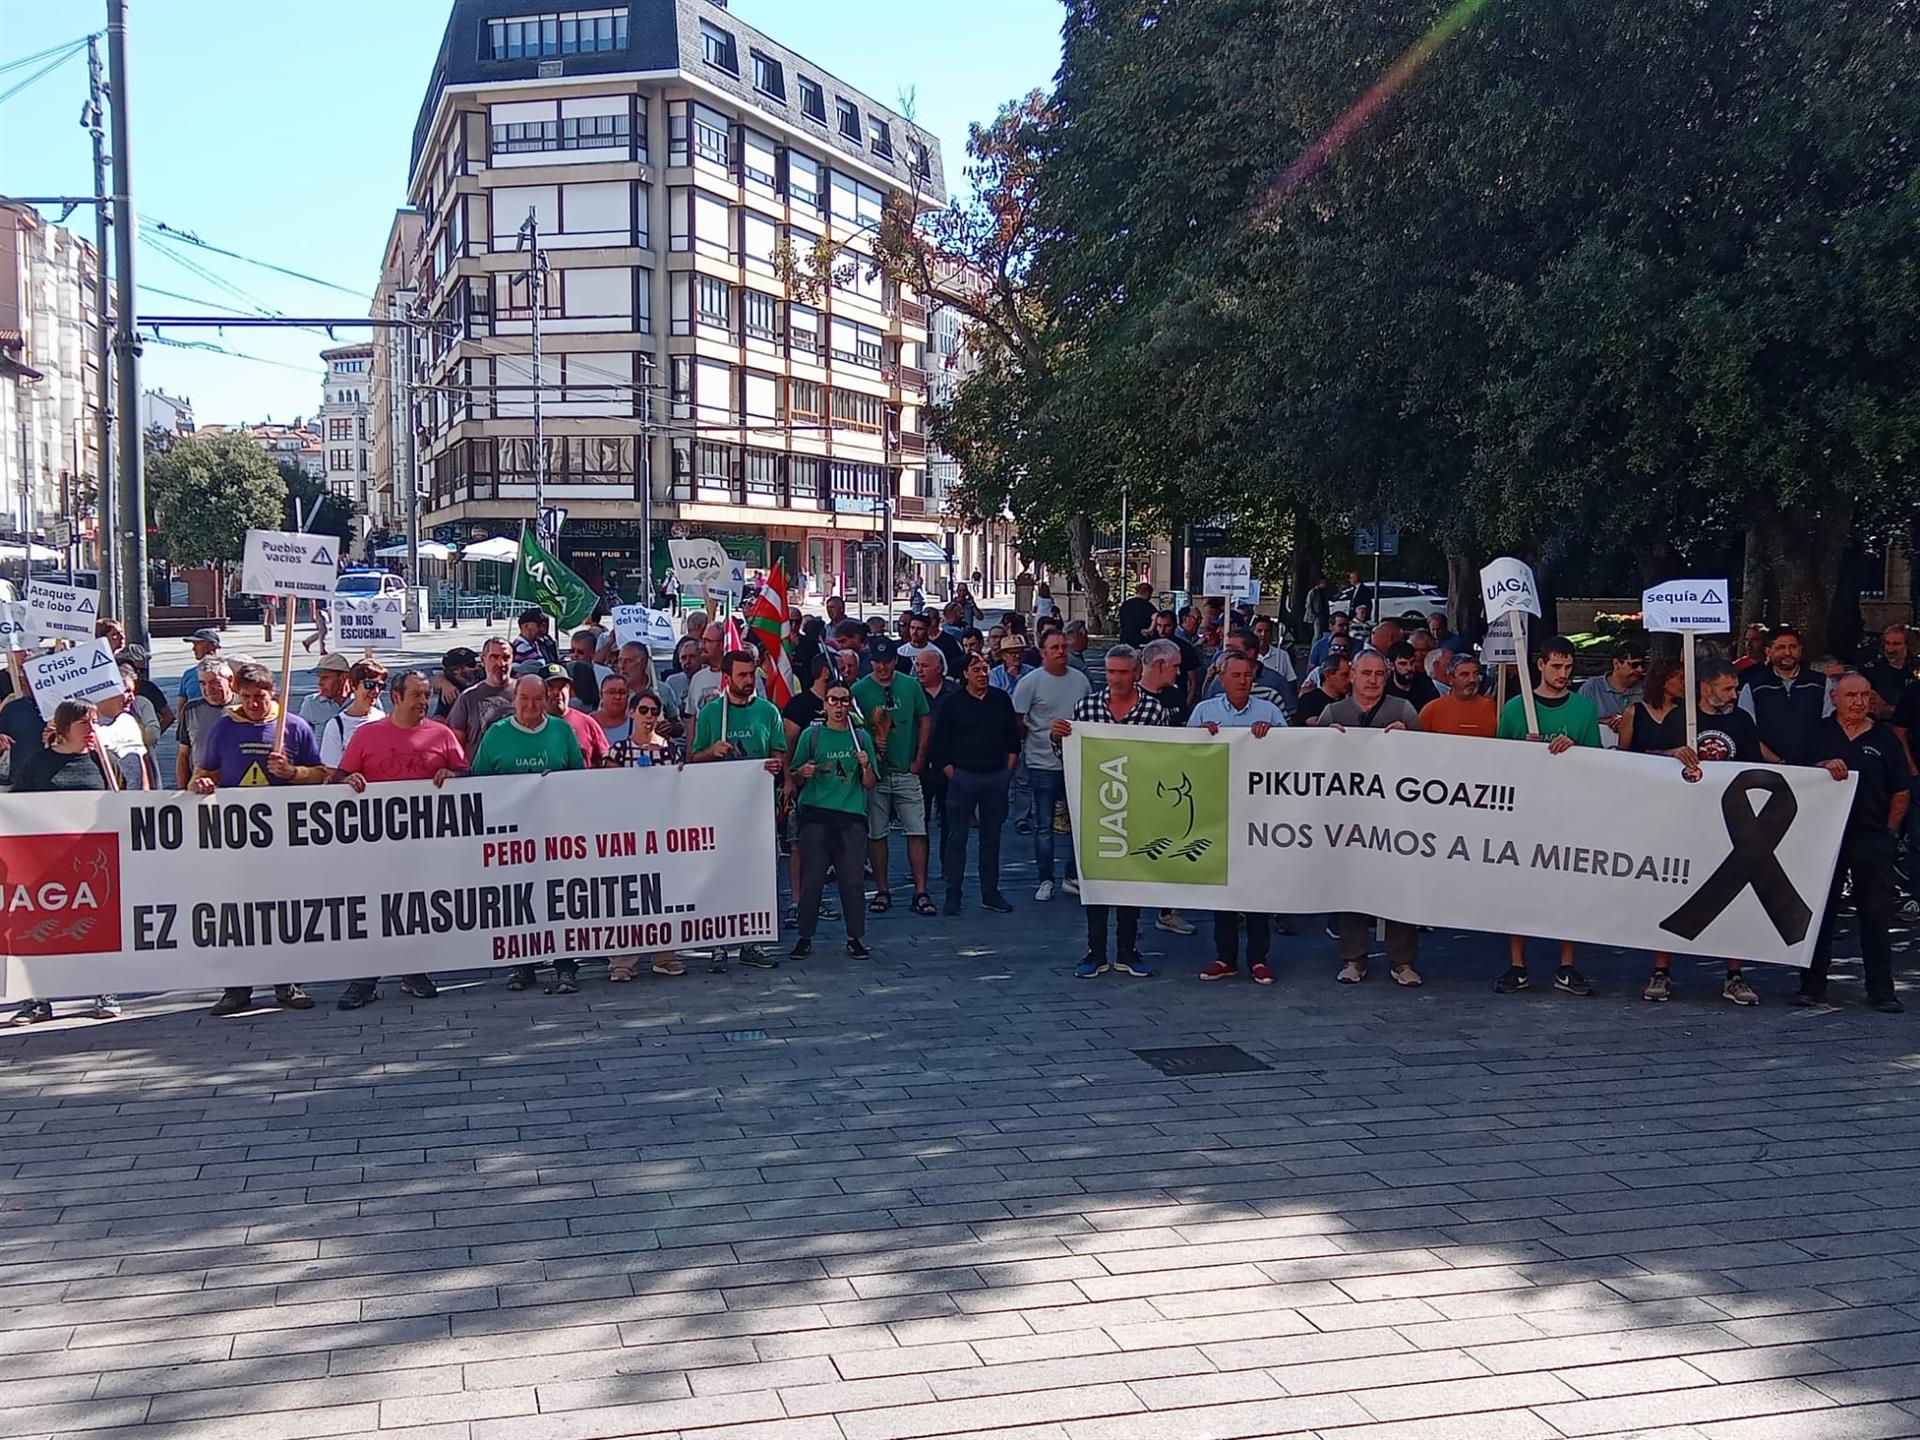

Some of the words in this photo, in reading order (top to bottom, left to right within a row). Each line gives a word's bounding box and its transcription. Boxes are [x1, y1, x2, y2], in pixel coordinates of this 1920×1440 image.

[262, 541, 308, 555] Pueblos
[678, 556, 720, 570] UAGA
[30, 585, 77, 601] Ataques
[1487, 578, 1531, 600] UAGA
[1647, 590, 1698, 605] sequía
[31, 598, 45, 609] de
[47, 600, 72, 613] lobo
[0, 622, 25, 635] GA
[340, 615, 353, 626] NO
[355, 615, 374, 626] NOS
[616, 616, 632, 626] del
[38, 655, 76, 674] Crisis
[34, 675, 56, 691] del
[57, 666, 88, 683] vino
[727, 730, 752, 739] UAGA
[515, 757, 545, 768] UAGA
[826, 750, 852, 760] UAGA
[1248, 770, 1386, 800] PIKUTARA
[1395, 777, 1516, 812] GOAZ!!!
[1098, 754, 1130, 859] UAGA
[130, 804, 183, 852] NO
[199, 803, 273, 850] NOS
[287, 791, 519, 848] ESCUCHAN...
[482, 838, 537, 868] PERO
[544, 834, 588, 863] NOS
[595, 831, 637, 859] VAN
[644, 829, 660, 855] A
[665, 826, 716, 854] OIR!!
[1248, 821, 1313, 849] NOS
[1323, 822, 1437, 859] VAMOS
[1446, 835, 1471, 862] A
[1482, 837, 1520, 867] LA
[1530, 842, 1692, 886] MIERDA!!!
[0, 881, 98, 913] AGA
[133, 903, 178, 952] EZ
[191, 895, 368, 949] GAITUZTE
[380, 881, 537, 938] KASURIK
[545, 871, 697, 923] EGITEN...
[492, 929, 557, 961] BAINA
[564, 920, 673, 954] ENTZUNGO
[680, 911, 772, 944] DIGUTE!!!
